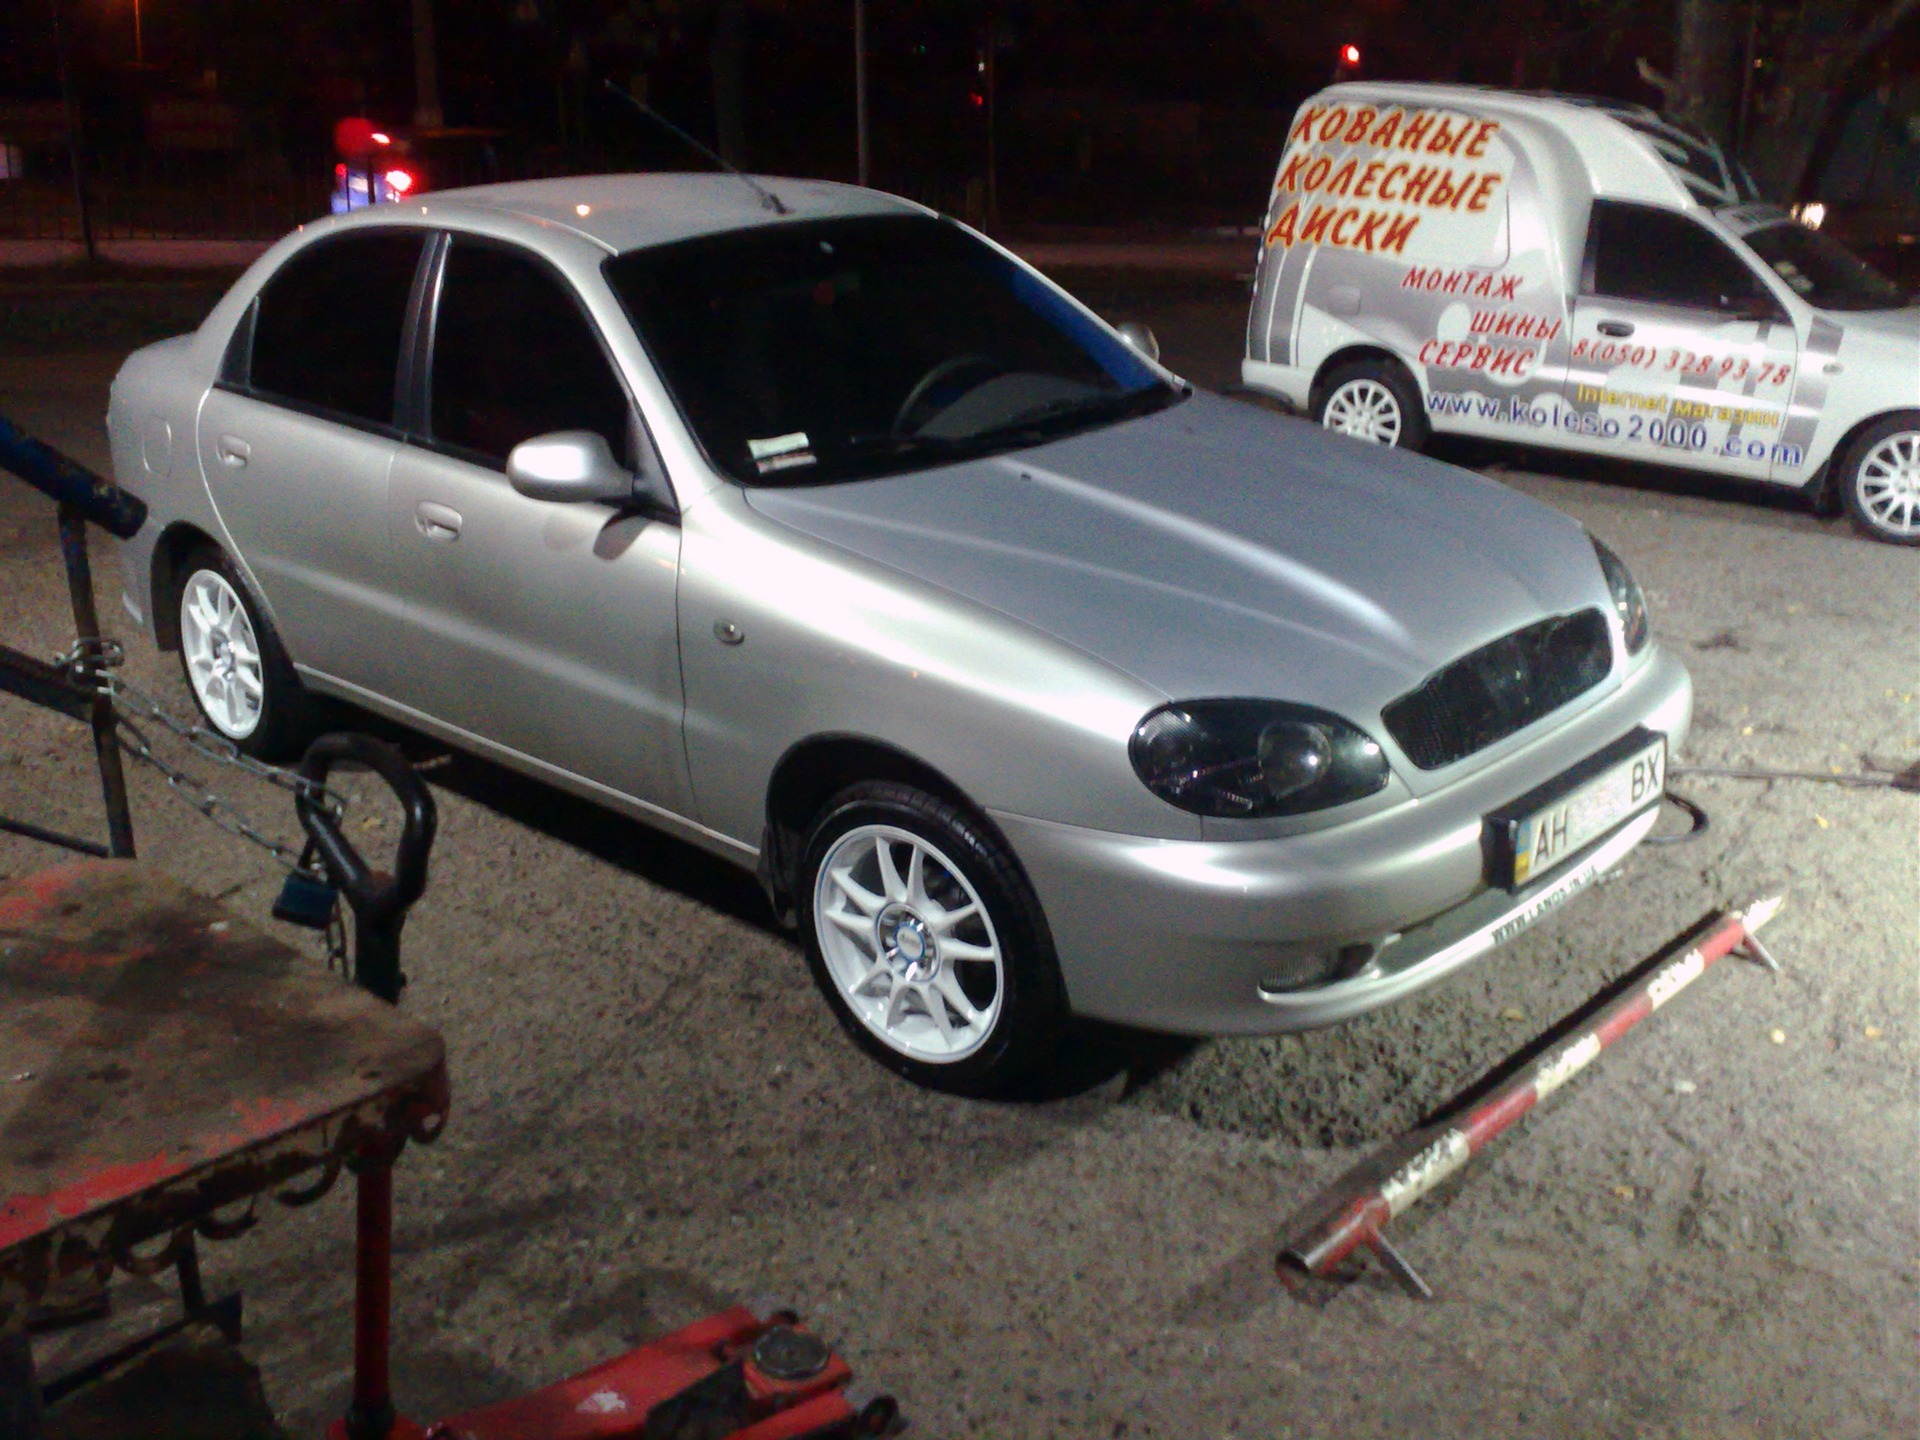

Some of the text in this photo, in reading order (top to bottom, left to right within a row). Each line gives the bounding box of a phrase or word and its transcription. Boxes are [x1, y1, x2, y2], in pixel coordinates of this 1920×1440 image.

[1291, 104, 1499, 159] КОВАНЫЕ
[1276, 152, 1502, 211] КОЛЕСНЫЕ
[1266, 199, 1420, 254] ДИСКИ
[1402, 265, 1524, 300] МОНТАЖ
[1469, 309, 1562, 341] ШИНЫ
[1418, 338, 1535, 376] СЕРВИС
[1572, 337, 1792, 386] 8(050) 328 93 78
[1577, 382, 1669, 414] Internet
[1427, 391, 1804, 466] www.koleso2000.com
[1534, 753, 1660, 865] AH BX
